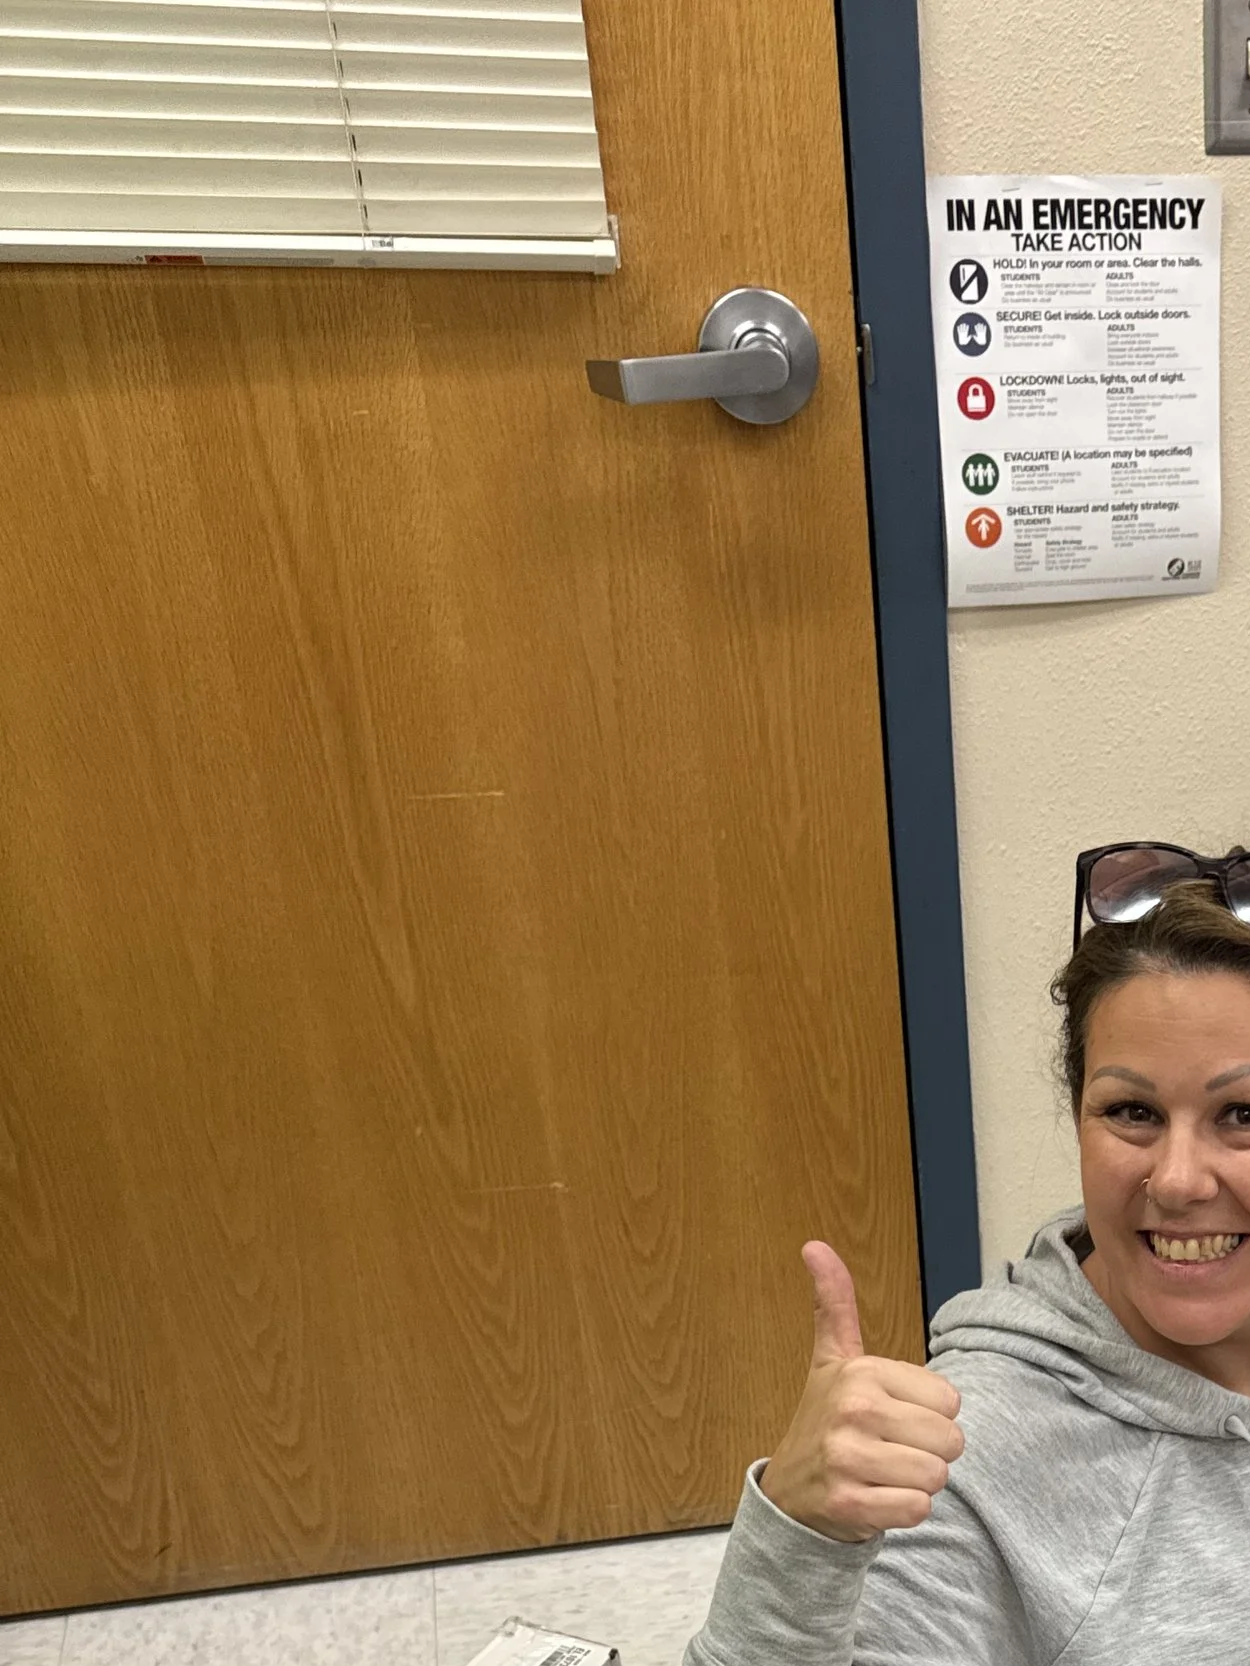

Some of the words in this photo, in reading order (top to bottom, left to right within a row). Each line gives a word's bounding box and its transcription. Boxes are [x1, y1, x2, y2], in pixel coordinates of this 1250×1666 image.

[946, 199, 975, 231] IN
[983, 198, 1023, 231] AN
[1032, 198, 1205, 230] EMERGENCY
[1011, 233, 1063, 252] TAKE
[1068, 232, 1142, 251] ACTION
[993, 259, 1027, 269] HOLD!
[1029, 259, 1039, 269] In
[1041, 260, 1063, 270] your
[1066, 260, 1092, 268] room
[1094, 260, 1104, 268] or
[1107, 260, 1131, 268] area.
[1133, 258, 1158, 268] Clear
[1161, 258, 1176, 267] the
[1178, 257, 1203, 267] halls.
[1000, 273, 1041, 281] STUDENTS
[1106, 272, 1134, 280] ADULTS
[996, 311, 1042, 321] SECURE!
[1044, 311, 1062, 321] Get
[1064, 311, 1095, 320] inside.
[1098, 311, 1121, 320] Lock
[1124, 310, 1159, 320] outside
[1161, 309, 1191, 319] doors.
[1004, 325, 1043, 333] STUDENTS
[1107, 324, 1135, 332] ADULTS
[1000, 375, 1064, 386] LOCKDOWN!
[1066, 375, 1098, 386] Locks,
[1100, 374, 1128, 385] lights,
[1131, 375, 1146, 384] out
[1149, 374, 1158, 383] of
[1160, 373, 1186, 384] sight.
[1007, 389, 1046, 397] STUDENTS
[1004, 451, 1059, 462] EVACUATE!
[1061, 450, 1072, 461] (A
[1073, 449, 1110, 460] location
[1113, 450, 1132, 460] may
[1135, 448, 1146, 457] be
[1148, 446, 1193, 459] specified)
[1011, 464, 1049, 472] STUDENTS
[1111, 461, 1138, 469] ADULTS
[1006, 506, 1054, 516] SHELTER!
[1056, 504, 1089, 514] Hazard
[1091, 504, 1109, 513] and
[1111, 502, 1138, 513] safety
[1140, 501, 1180, 512] strategy.
[1013, 518, 1051, 526] STUDENTS
[1112, 514, 1139, 522] ADULTS
